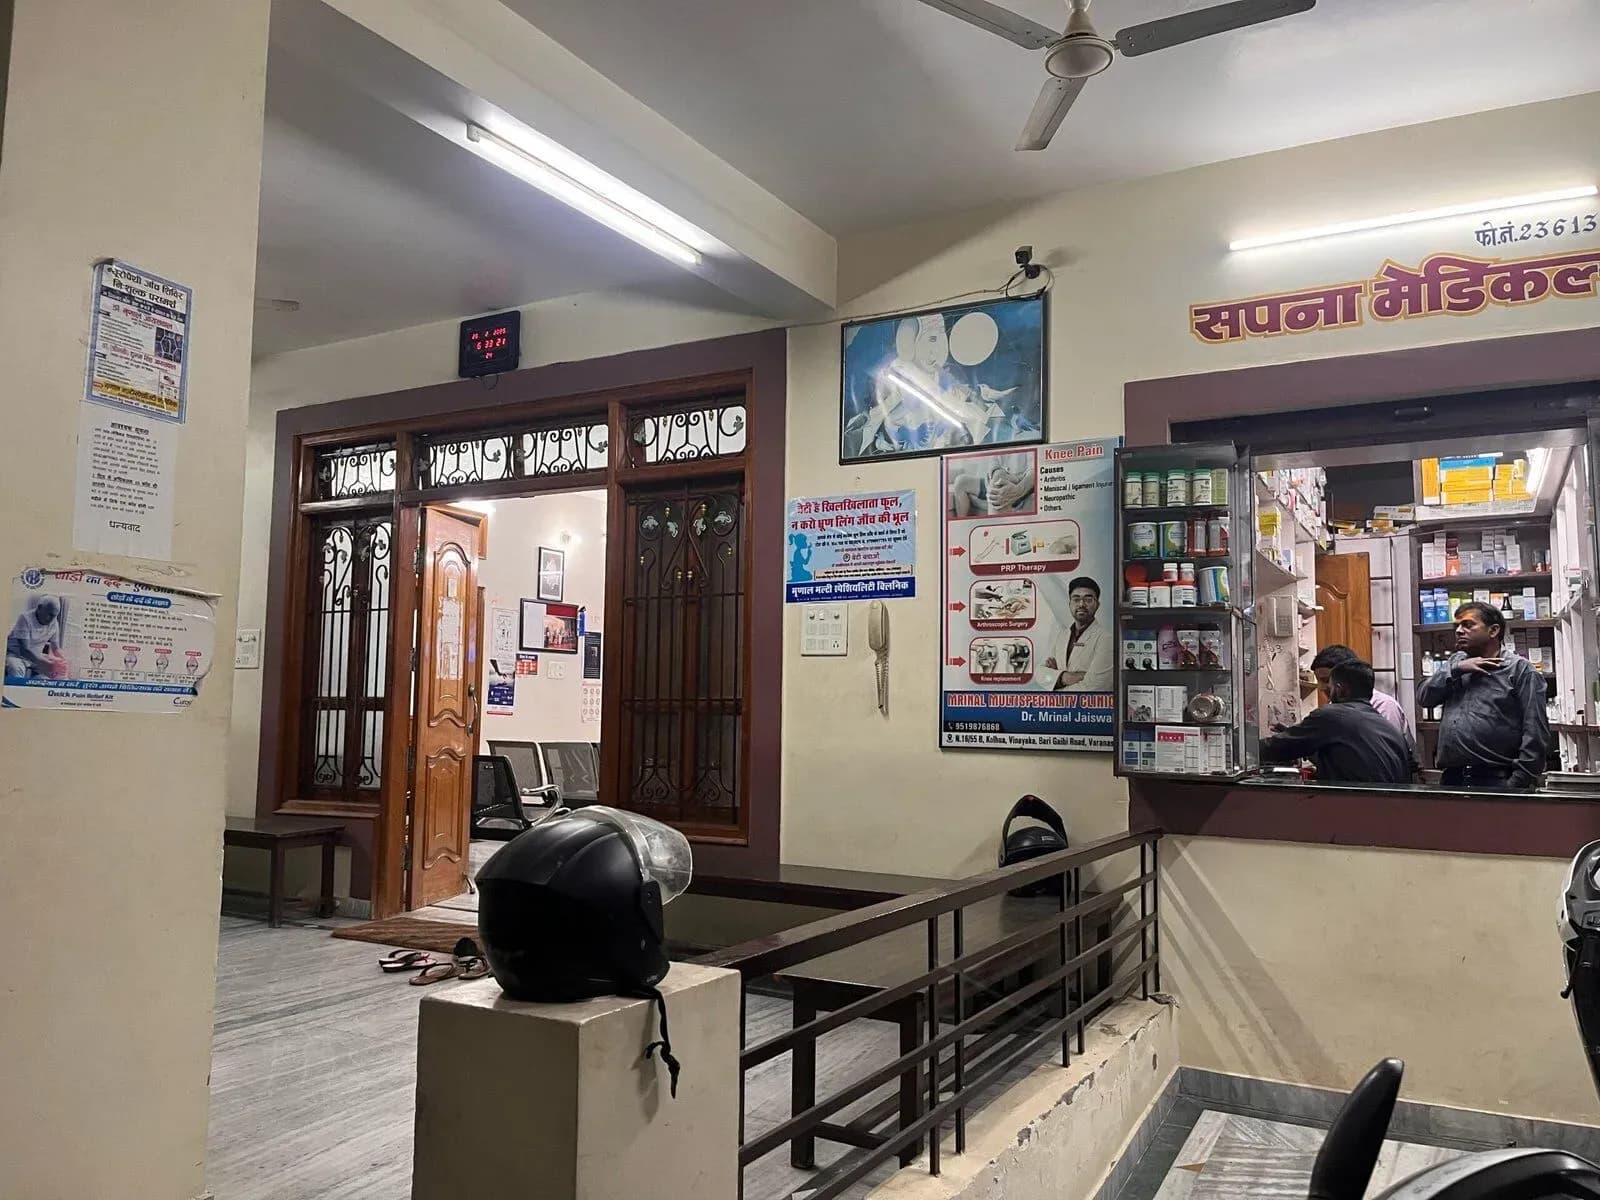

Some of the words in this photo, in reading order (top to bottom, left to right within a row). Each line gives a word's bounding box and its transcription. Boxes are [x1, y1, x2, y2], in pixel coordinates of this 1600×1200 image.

[1190, 282, 1365, 344] सपना
[1368, 250, 1600, 321] मेडिकल
[1045, 448, 1074, 461] Knee
[1077, 445, 1104, 457] Pain
[1040, 466, 1064, 474] Causes
[1072, 482, 1096, 491] ligament
[1044, 494, 1076, 502] Neuropathic
[813, 501, 821, 513] है
[822, 498, 879, 512] खिलखिलाता
[109, 520, 141, 533] धन्यवाद
[791, 520, 799, 530] न
[800, 516, 817, 530] करो
[818, 517, 834, 532] भ्रूण
[835, 514, 855, 527] लिंग
[878, 511, 892, 523] की
[893, 511, 910, 526] भूल
[1001, 564, 1016, 572] PRP
[1018, 562, 1047, 573] Therapy
[792, 586, 813, 597] मृणाल
[815, 582, 832, 594] मल्टी
[977, 620, 1008, 629] Arthroscopic
[1009, 620, 1028, 629] Surgery
[47, 690, 70, 698] Quick
[71, 691, 86, 699] Pain
[948, 693, 987, 707] MRINAL
[988, 693, 1078, 708] MULTISPECIALITY
[1021, 711, 1036, 722] Dr.
[1038, 710, 1072, 722] Mrinal
[1074, 711, 1113, 723] Jaiswa
